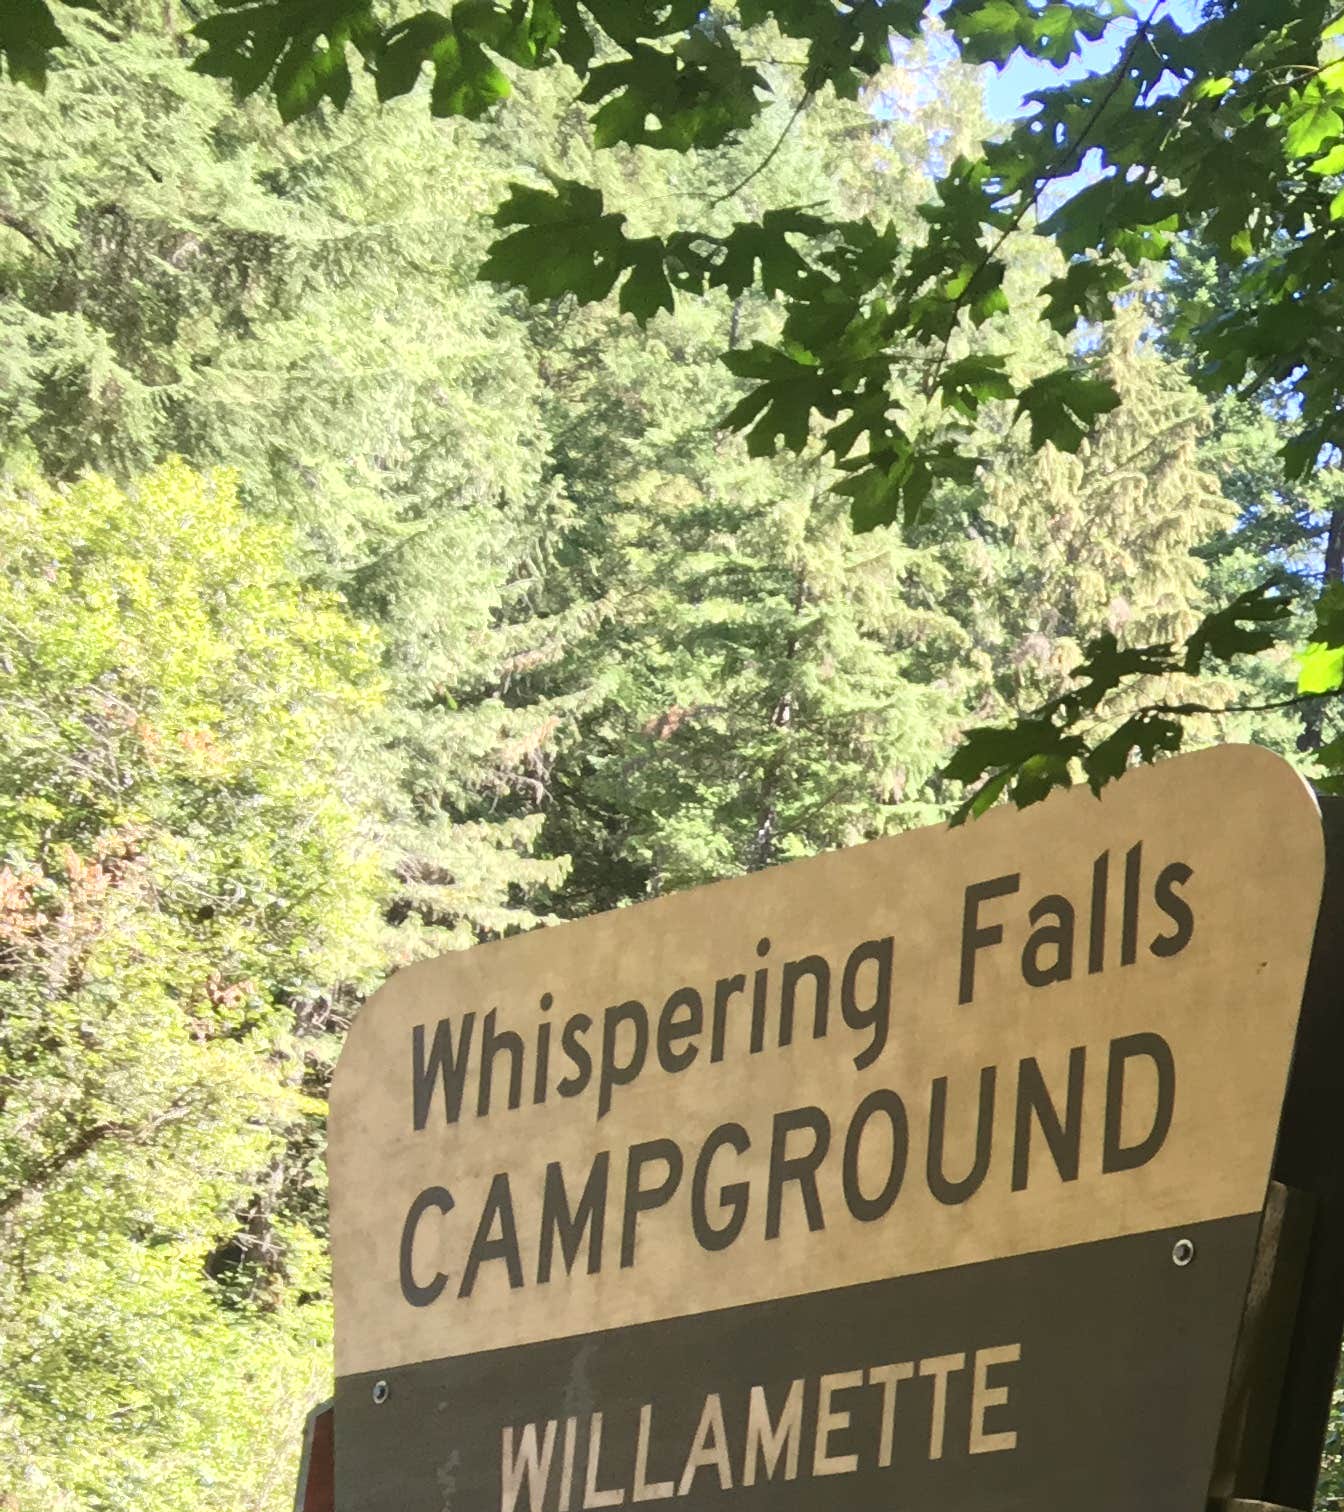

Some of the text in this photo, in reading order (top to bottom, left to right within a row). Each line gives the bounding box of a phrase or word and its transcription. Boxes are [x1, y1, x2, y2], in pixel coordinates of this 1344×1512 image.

[411, 840, 1196, 1131] Whispering Falls
[399, 1031, 1176, 1308] CAMPGROUND
